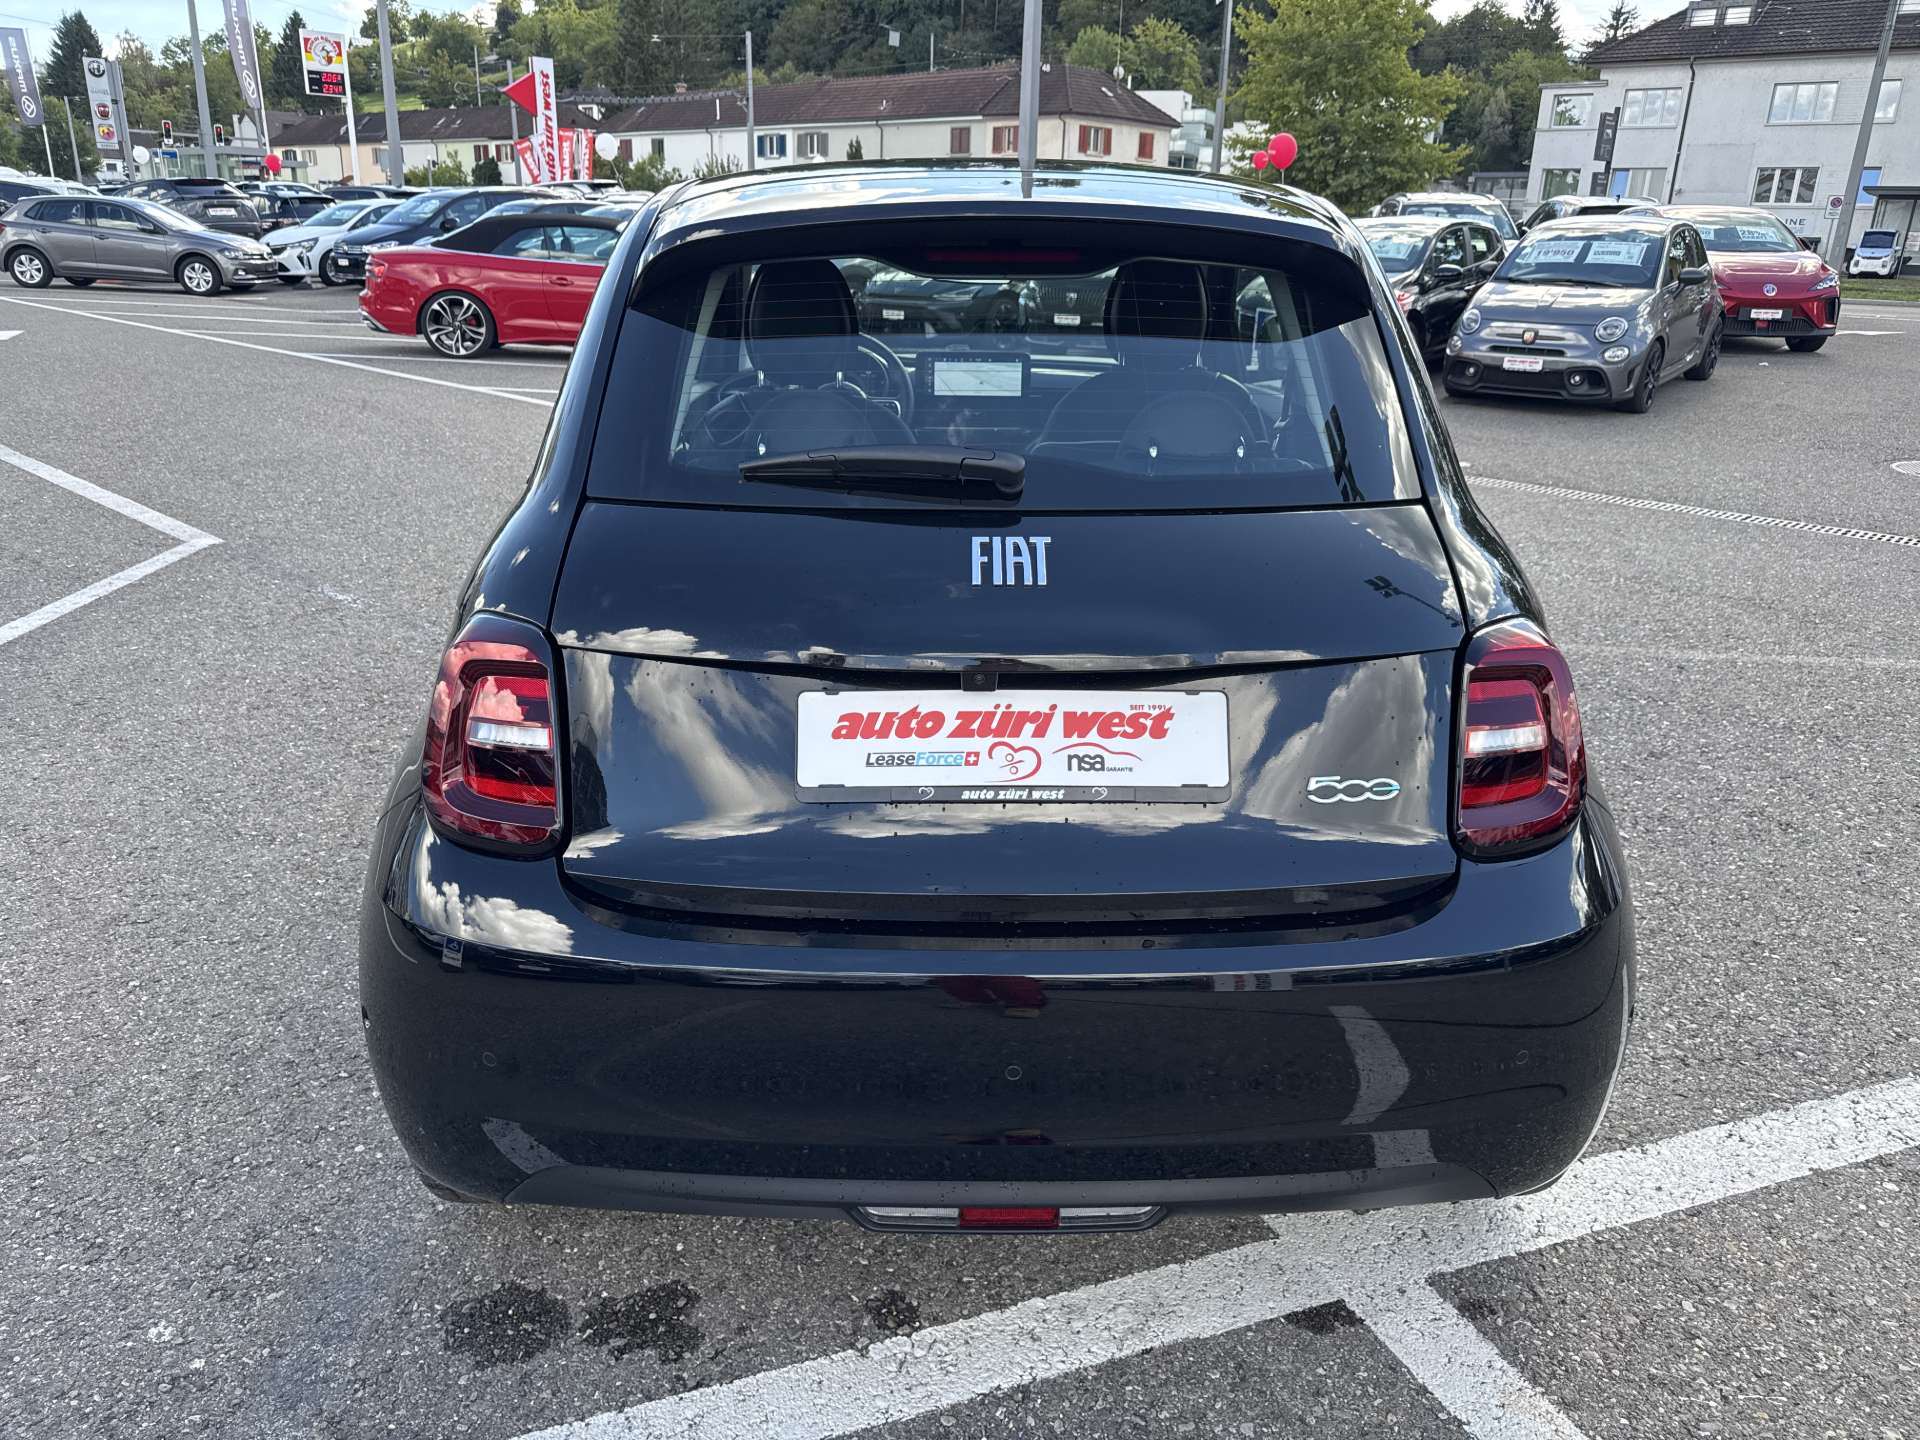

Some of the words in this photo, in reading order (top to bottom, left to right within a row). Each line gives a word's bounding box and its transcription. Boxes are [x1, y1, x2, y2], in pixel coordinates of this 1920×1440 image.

[541, 69, 552, 111] west
[545, 152, 556, 182] uto
[971, 536, 1052, 586] FIAT
[831, 704, 946, 740] auto
[945, 703, 1058, 739] züri
[1063, 705, 1175, 740] west
[865, 752, 964, 767] LeaseForce
[1067, 753, 1105, 772] nsa
[961, 789, 995, 800] auto
[996, 788, 1028, 800] züri
[1031, 788, 1065, 800] west
[1307, 775, 1400, 803] 500
